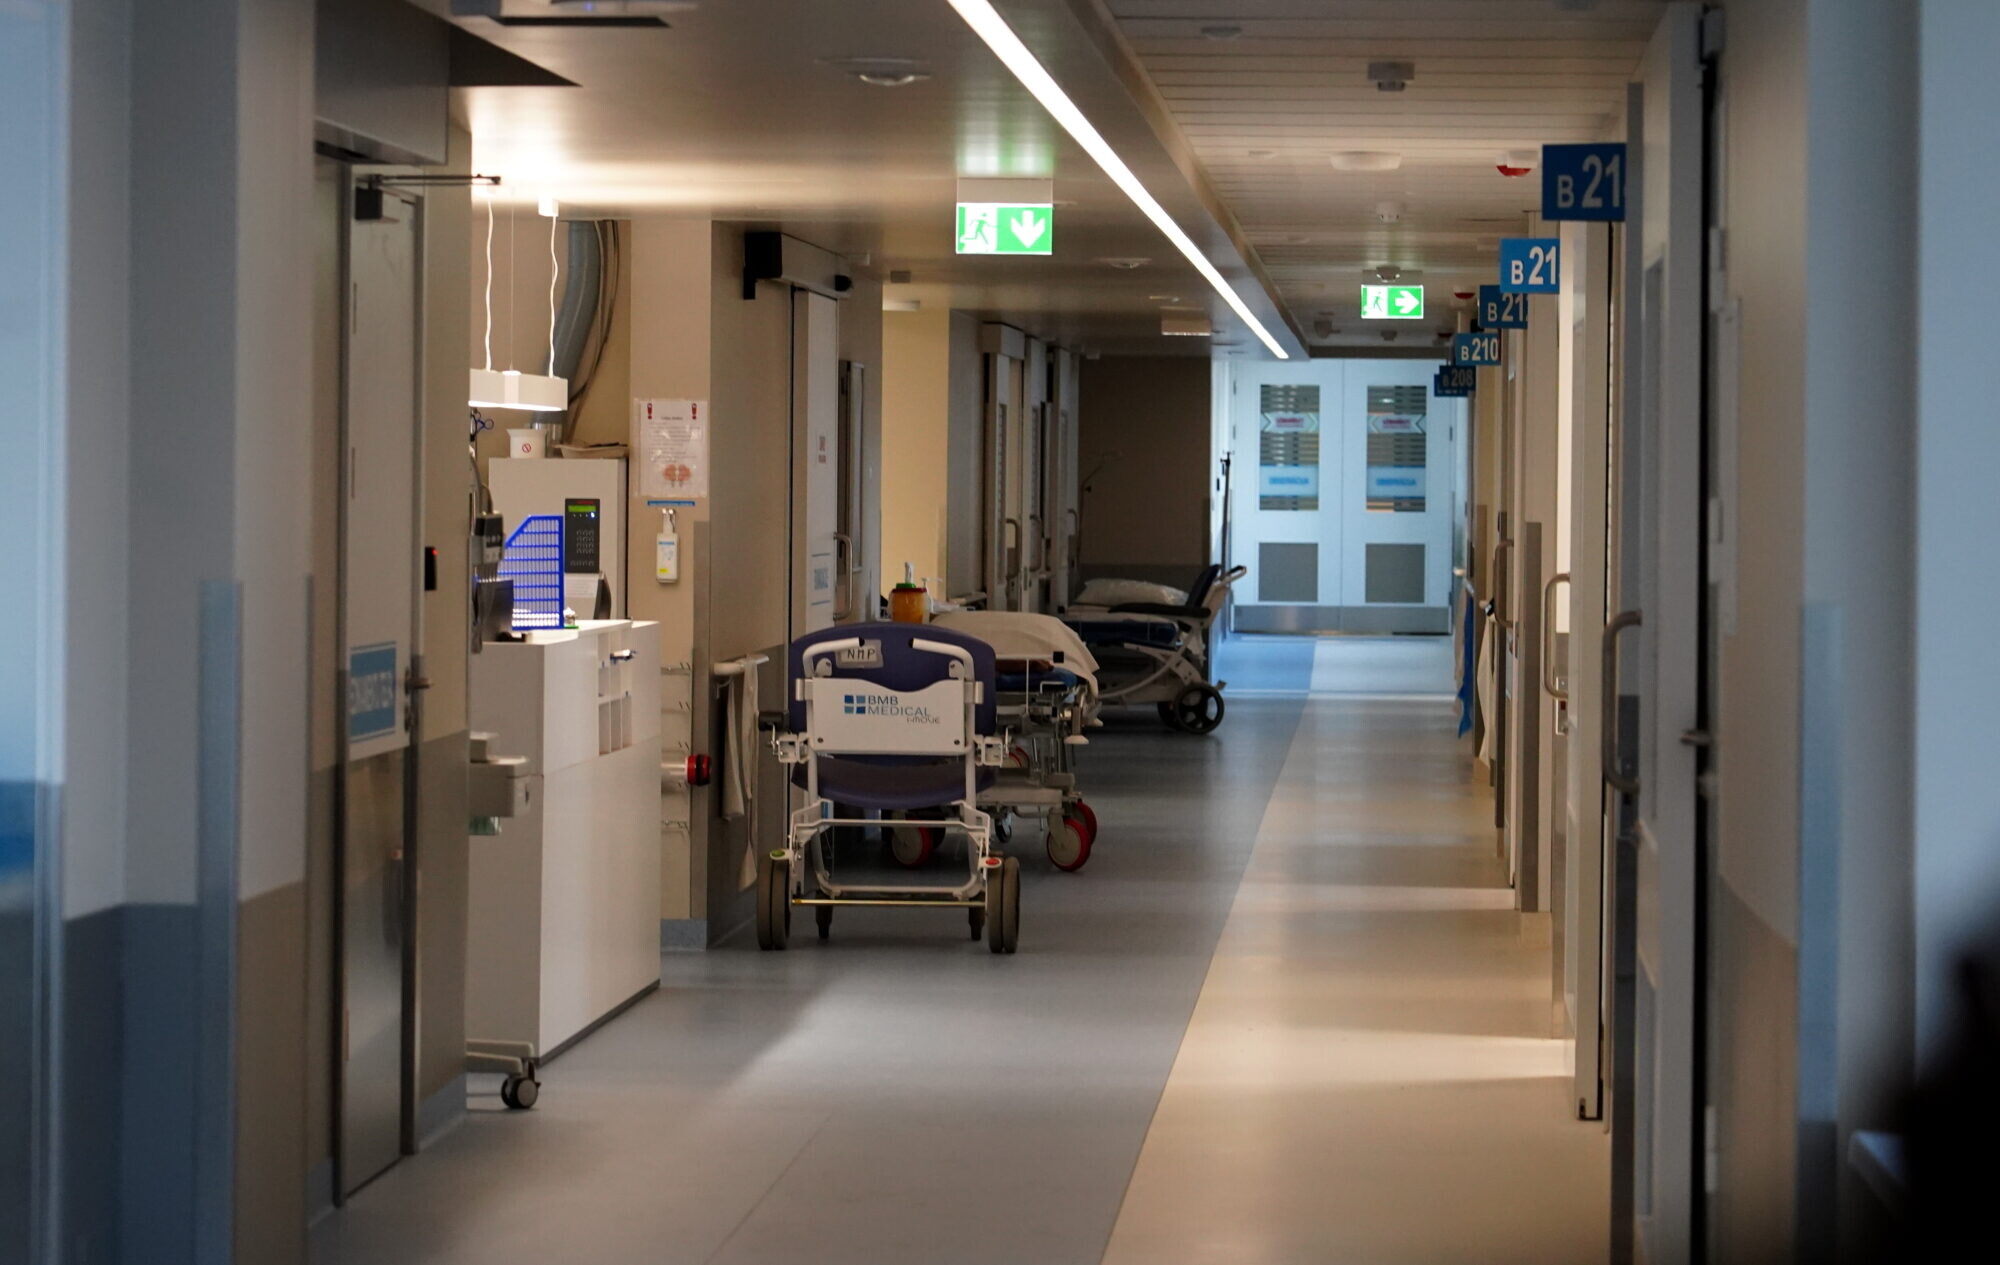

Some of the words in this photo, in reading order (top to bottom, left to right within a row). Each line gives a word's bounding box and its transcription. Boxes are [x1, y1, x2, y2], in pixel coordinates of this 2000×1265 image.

[1557, 174, 1575, 209] B
[1582, 153, 1626, 209] 21
[1511, 259, 1524, 285] B
[1487, 301, 1498, 323] B
[1501, 291, 1528, 322] 21
[1460, 345, 1470, 361] B
[1471, 336, 1499, 361] 210
[1450, 367, 1474, 388] 208
[867, 694, 899, 706] BMB
[867, 705, 931, 717] MEDICAL
